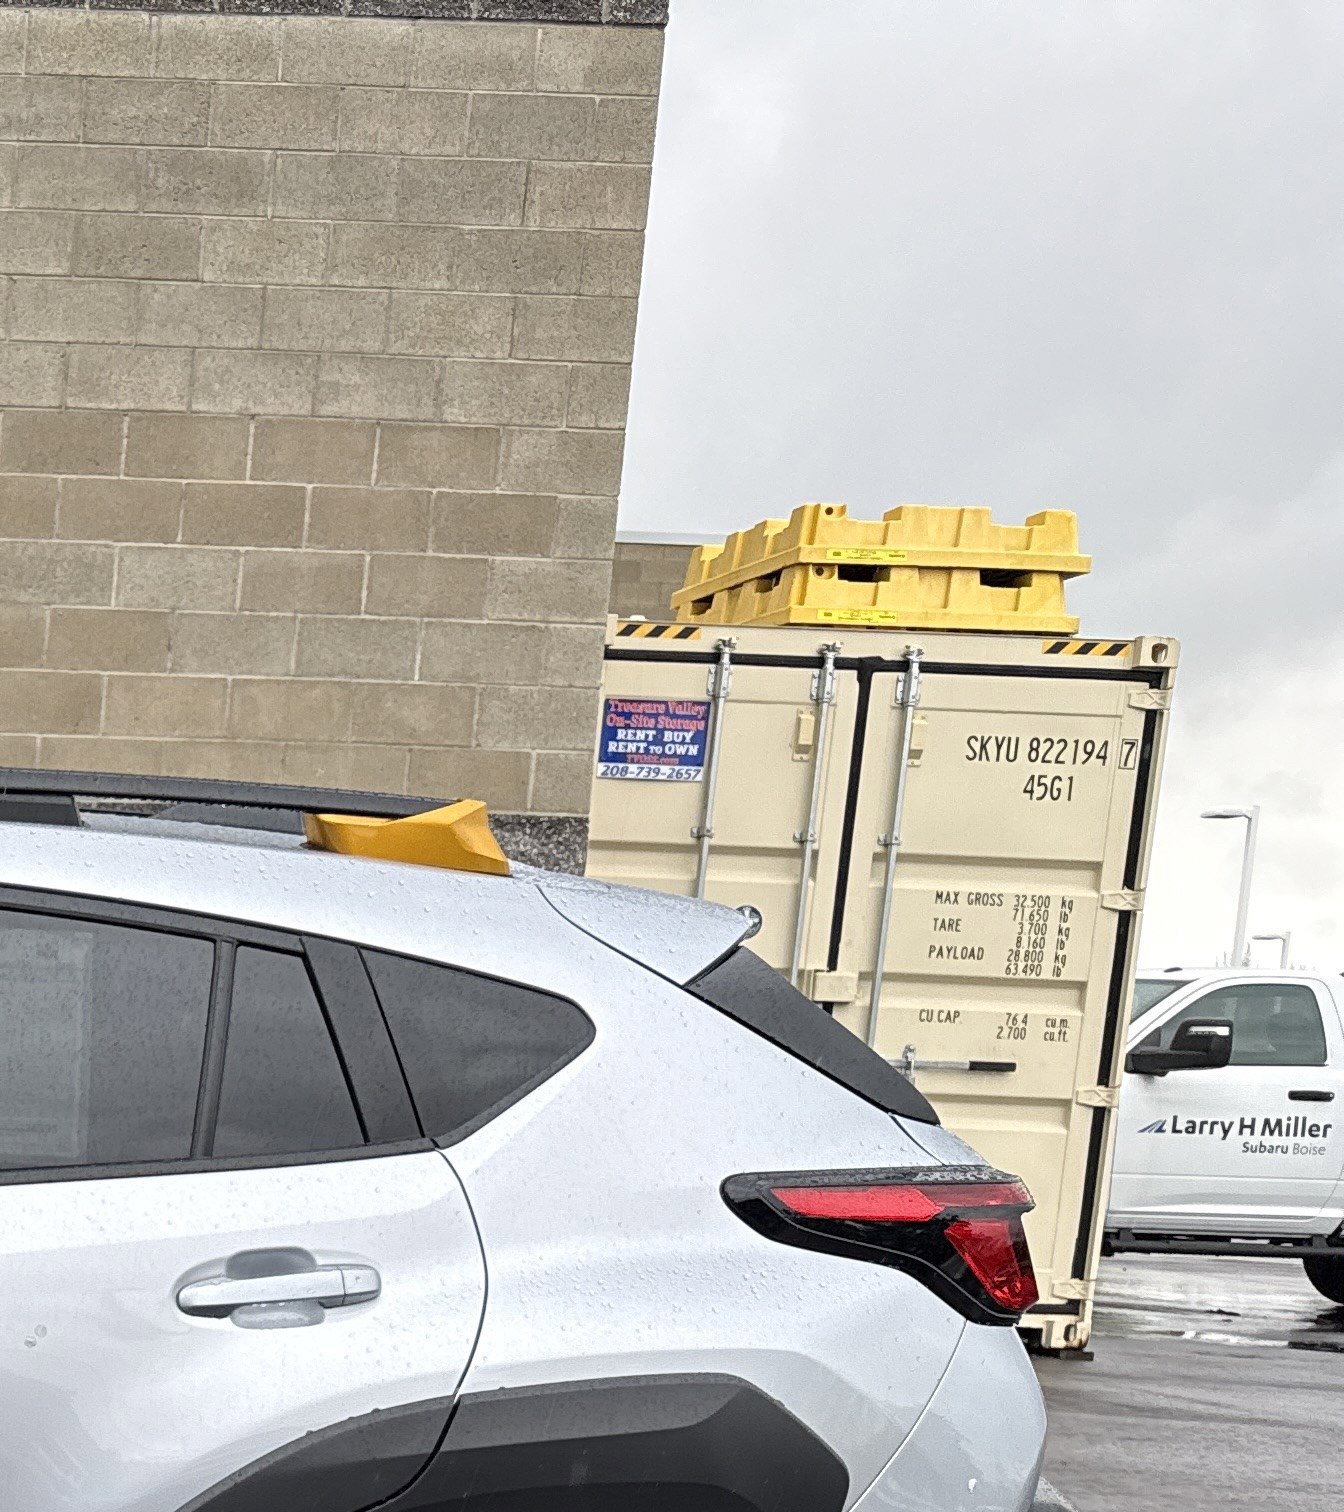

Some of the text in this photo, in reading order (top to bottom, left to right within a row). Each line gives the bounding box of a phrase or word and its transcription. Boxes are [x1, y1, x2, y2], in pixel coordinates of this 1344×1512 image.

[668, 701, 706, 718] Valley
[657, 715, 705, 731] Storage
[616, 729, 694, 742] RENT BUY
[607, 741, 647, 753] RENT
[665, 743, 699, 756] OWN
[965, 735, 1020, 763] SKYU
[1027, 737, 1109, 766] 822194
[601, 764, 701, 780] 208-739-2657
[1023, 774, 1074, 801] 45G1
[935, 890, 960, 905] MAX
[967, 892, 1004, 907] GROSS
[1061, 896, 1074, 914] kg
[933, 918, 962, 932] TARE
[1057, 924, 1070, 941] kg
[928, 945, 985, 961] PAYLOAD
[1054, 952, 1067, 968] kg
[1171, 1115, 1332, 1141] Larry H Miller
[1242, 1141, 1326, 1156] Subaru Boise
